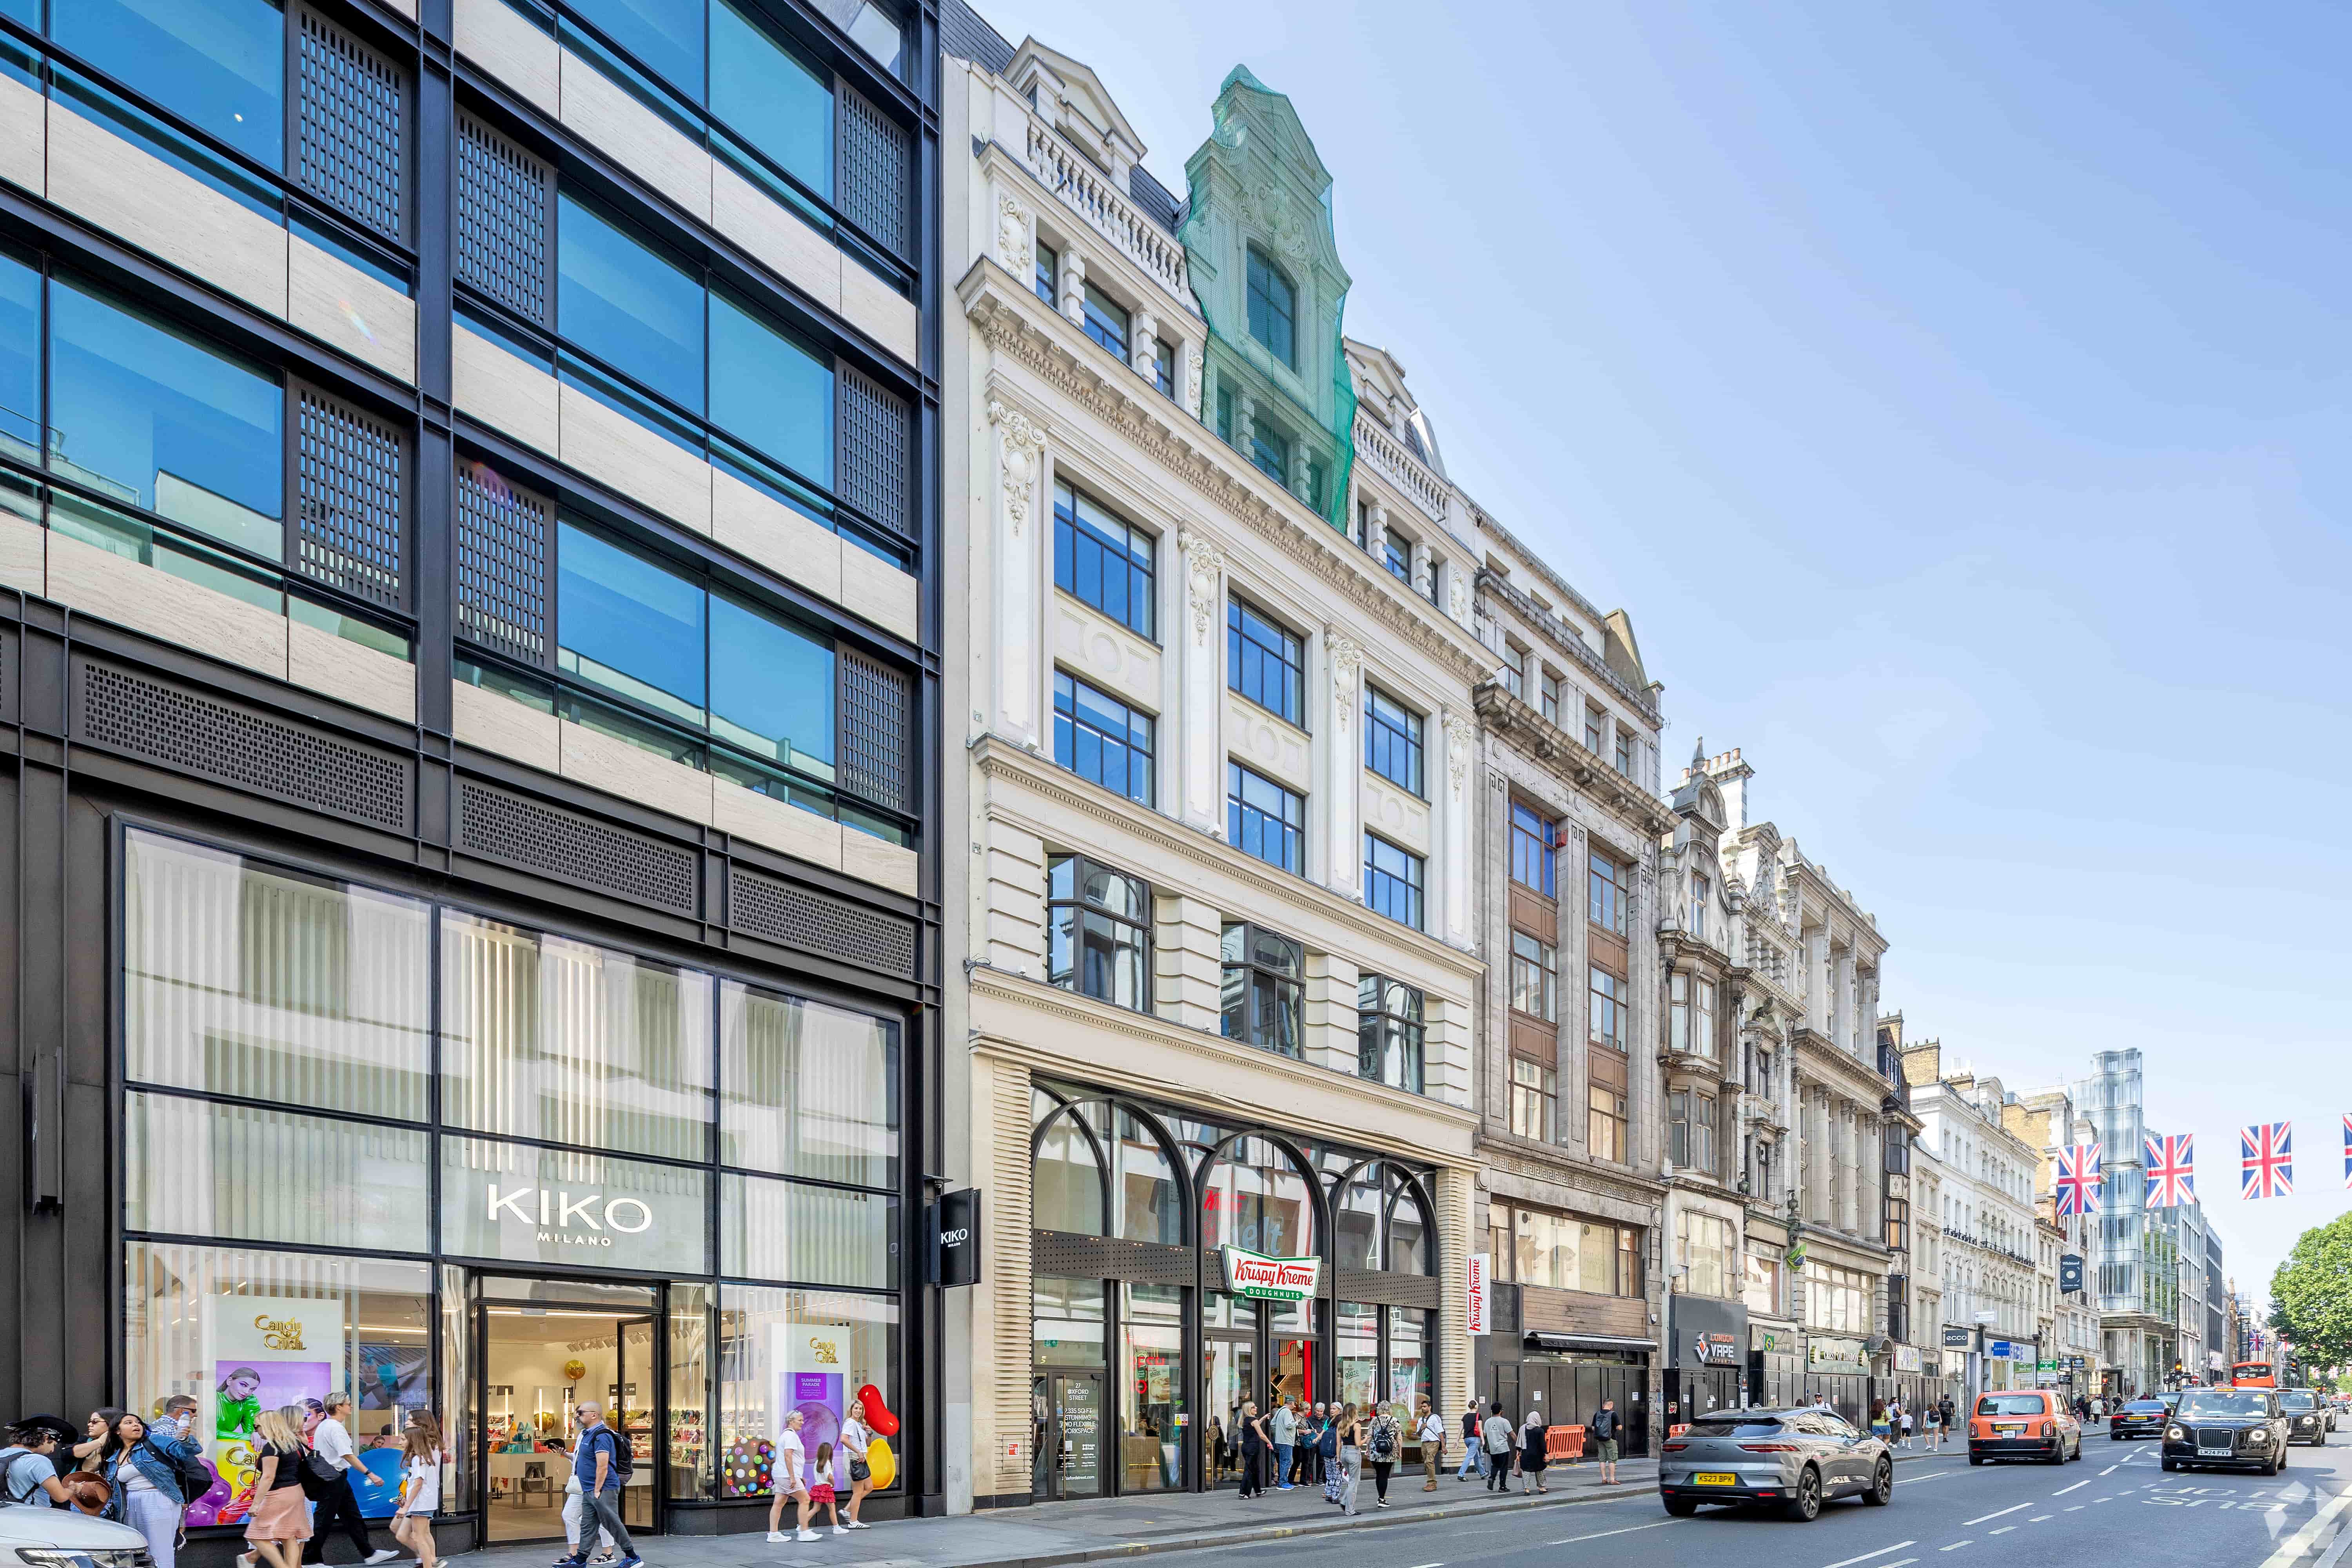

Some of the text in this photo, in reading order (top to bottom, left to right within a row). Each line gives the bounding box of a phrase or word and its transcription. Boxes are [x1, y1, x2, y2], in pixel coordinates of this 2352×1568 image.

[487, 1183, 652, 1233] KIKO
[537, 1232, 611, 1247] MILANO
[941, 1229, 967, 1244] KIKO
[1235, 1258, 1315, 1287] Krispy Kreme
[1249, 1288, 1299, 1299] DOUGHNUTS
[1468, 1258, 1483, 1332] Krispy Kreme
[254, 1314, 302, 1338] Candy
[264, 1334, 303, 1350] Crush
[809, 1337, 836, 1352] Candy
[1709, 1333, 1734, 1343] LONDON
[1711, 1344, 1734, 1358] VAPE
[1837, 1352, 1842, 1360] OF
[1843, 1352, 1858, 1361] LONDON
[2141, 1496, 2289, 1512] BUS
